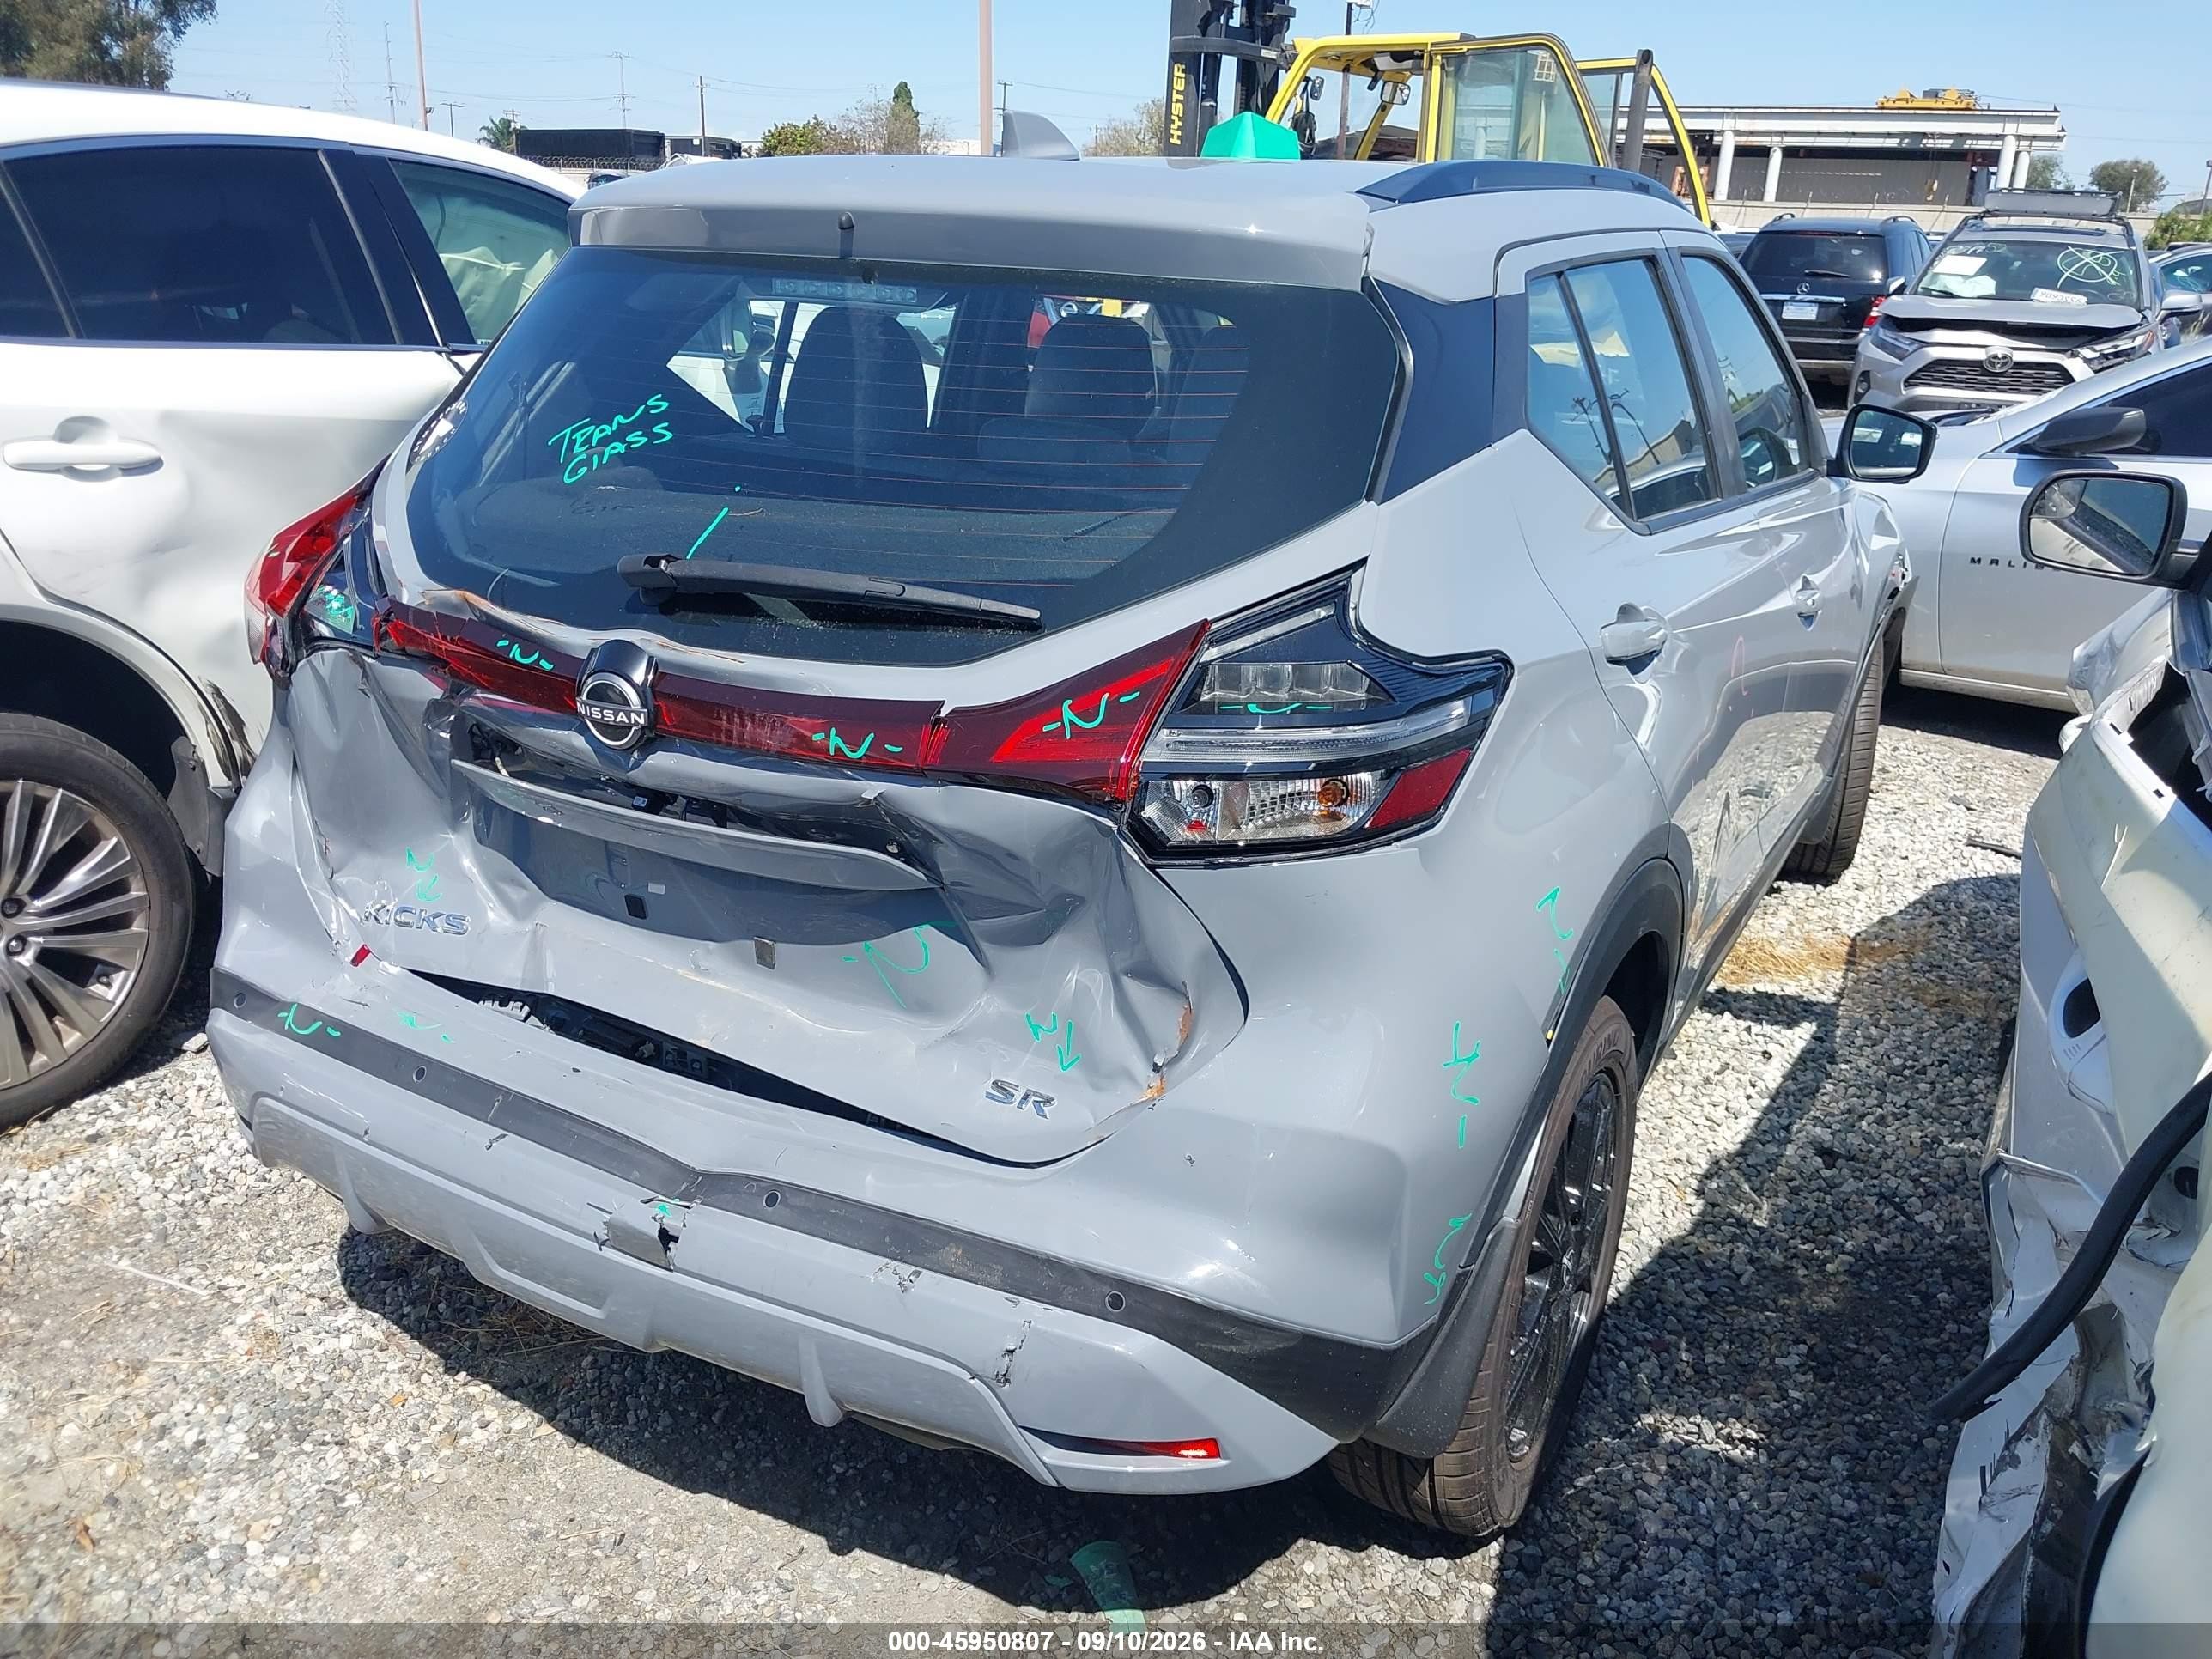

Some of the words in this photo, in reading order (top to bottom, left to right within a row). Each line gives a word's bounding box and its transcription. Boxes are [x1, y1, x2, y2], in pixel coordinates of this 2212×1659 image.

[1170, 63, 1186, 145] HYSTER
[576, 700, 646, 726] NISSAN
[363, 900, 471, 936] KICKS
[985, 1079, 1057, 1120] SR
